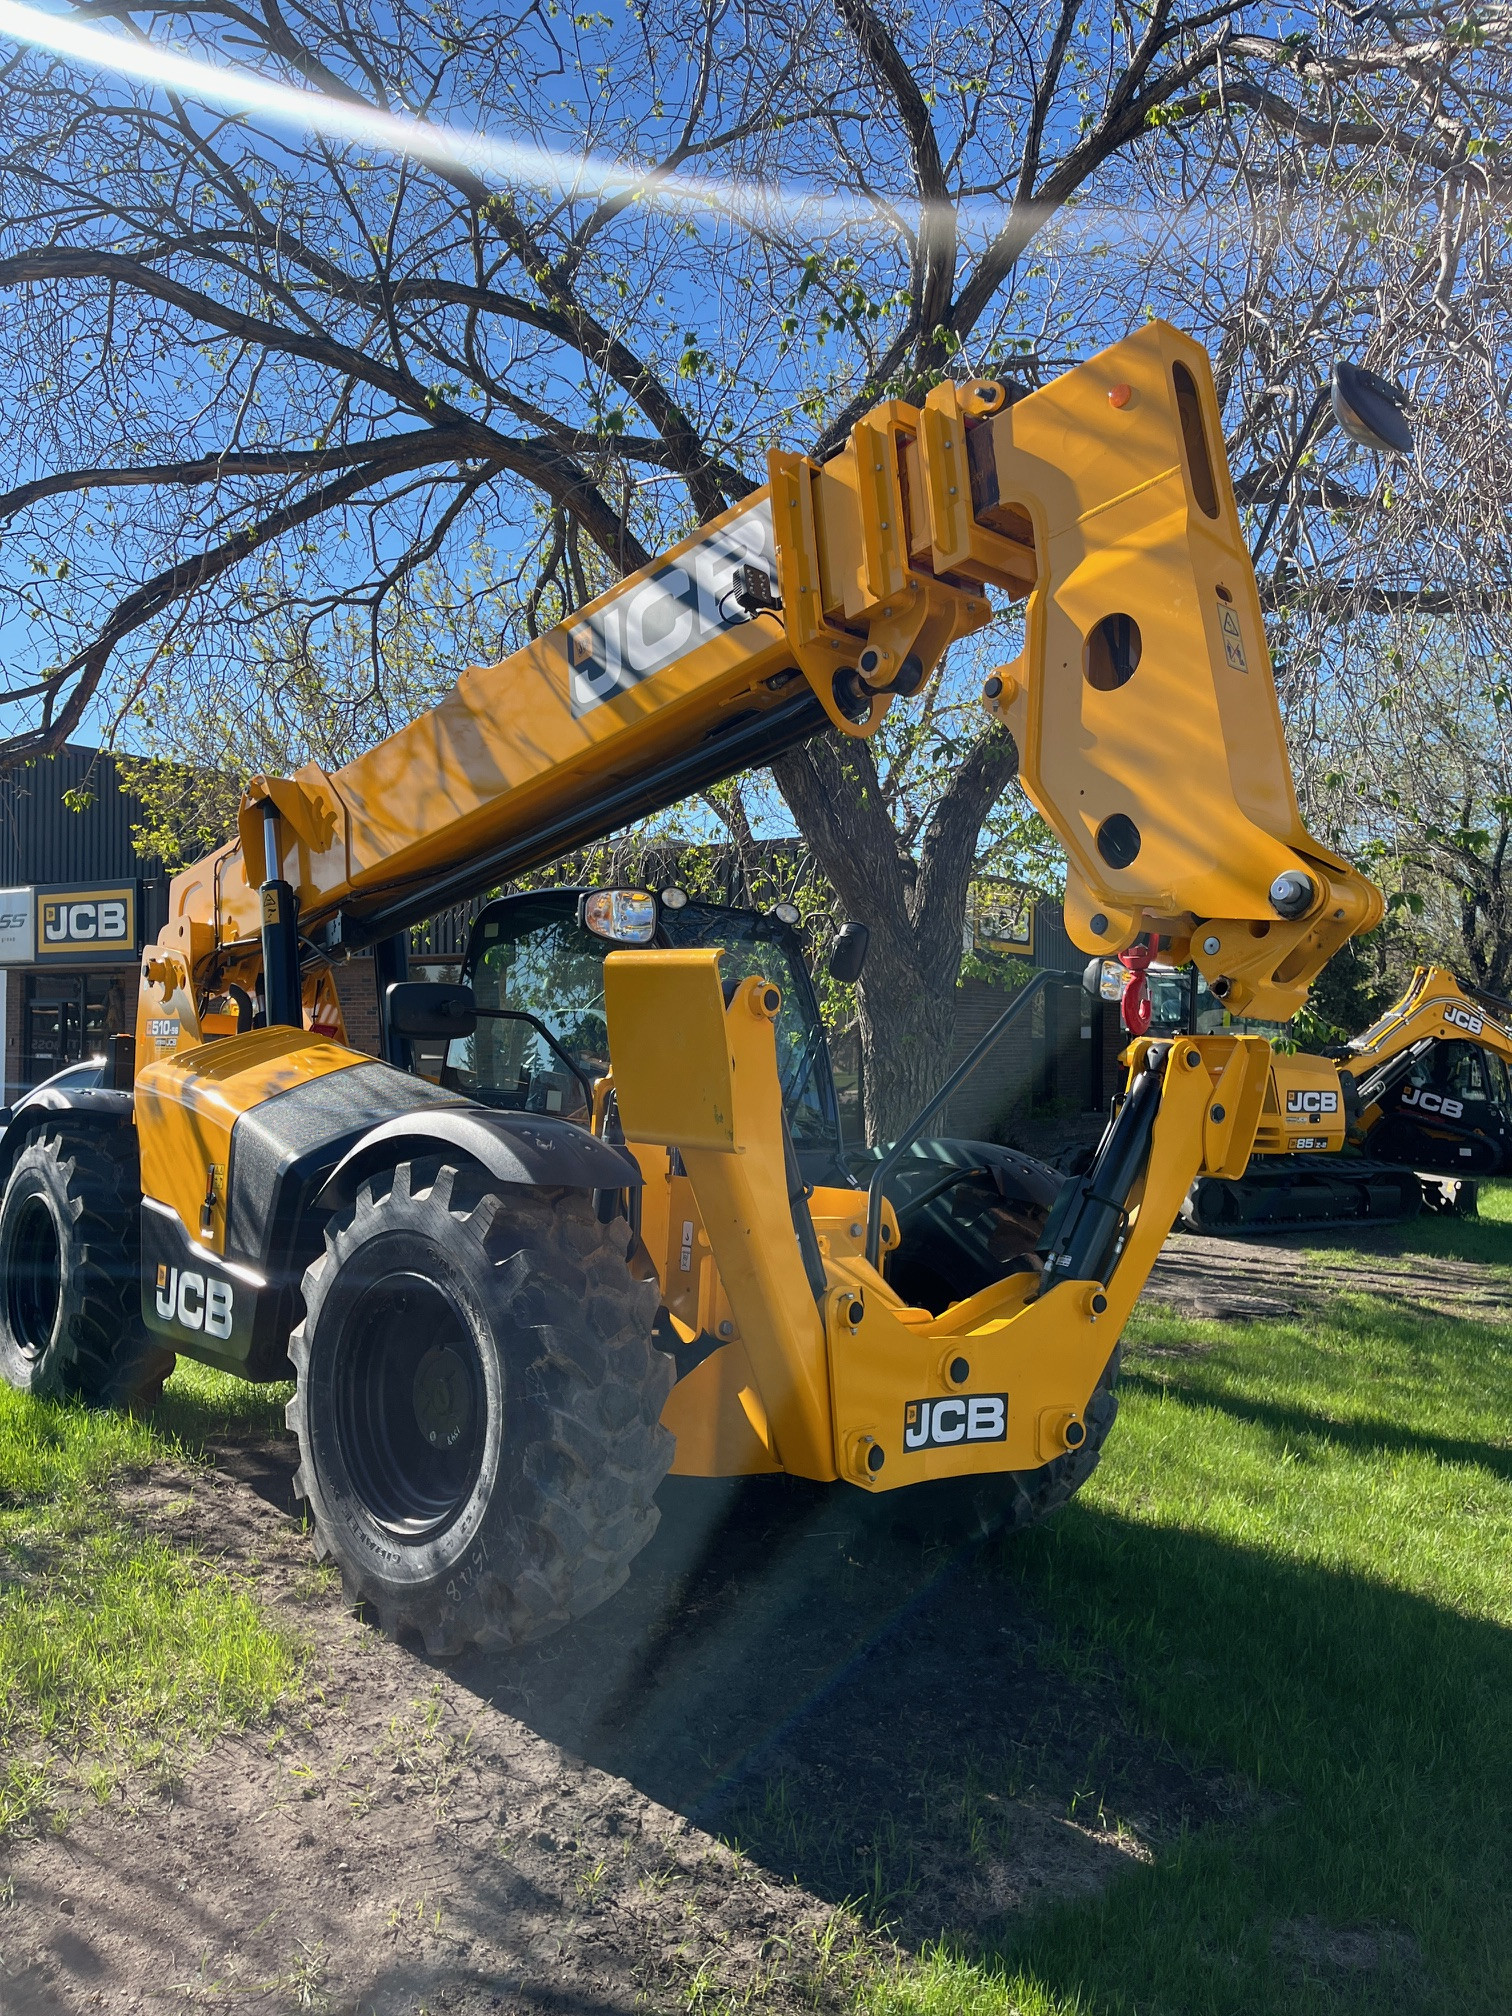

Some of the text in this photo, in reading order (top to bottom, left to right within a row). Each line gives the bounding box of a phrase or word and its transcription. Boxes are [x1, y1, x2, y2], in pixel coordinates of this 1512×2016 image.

[574, 520, 770, 704] JCB
[46, 903, 126, 940] JCB
[1444, 1008, 1483, 1035] JCB
[1288, 1092, 1337, 1111] JCB
[1401, 1089, 1463, 1118] JCB
[1297, 1138, 1314, 1149] 85
[156, 1266, 234, 1340] JCB
[906, 1398, 1004, 1448] JCB
